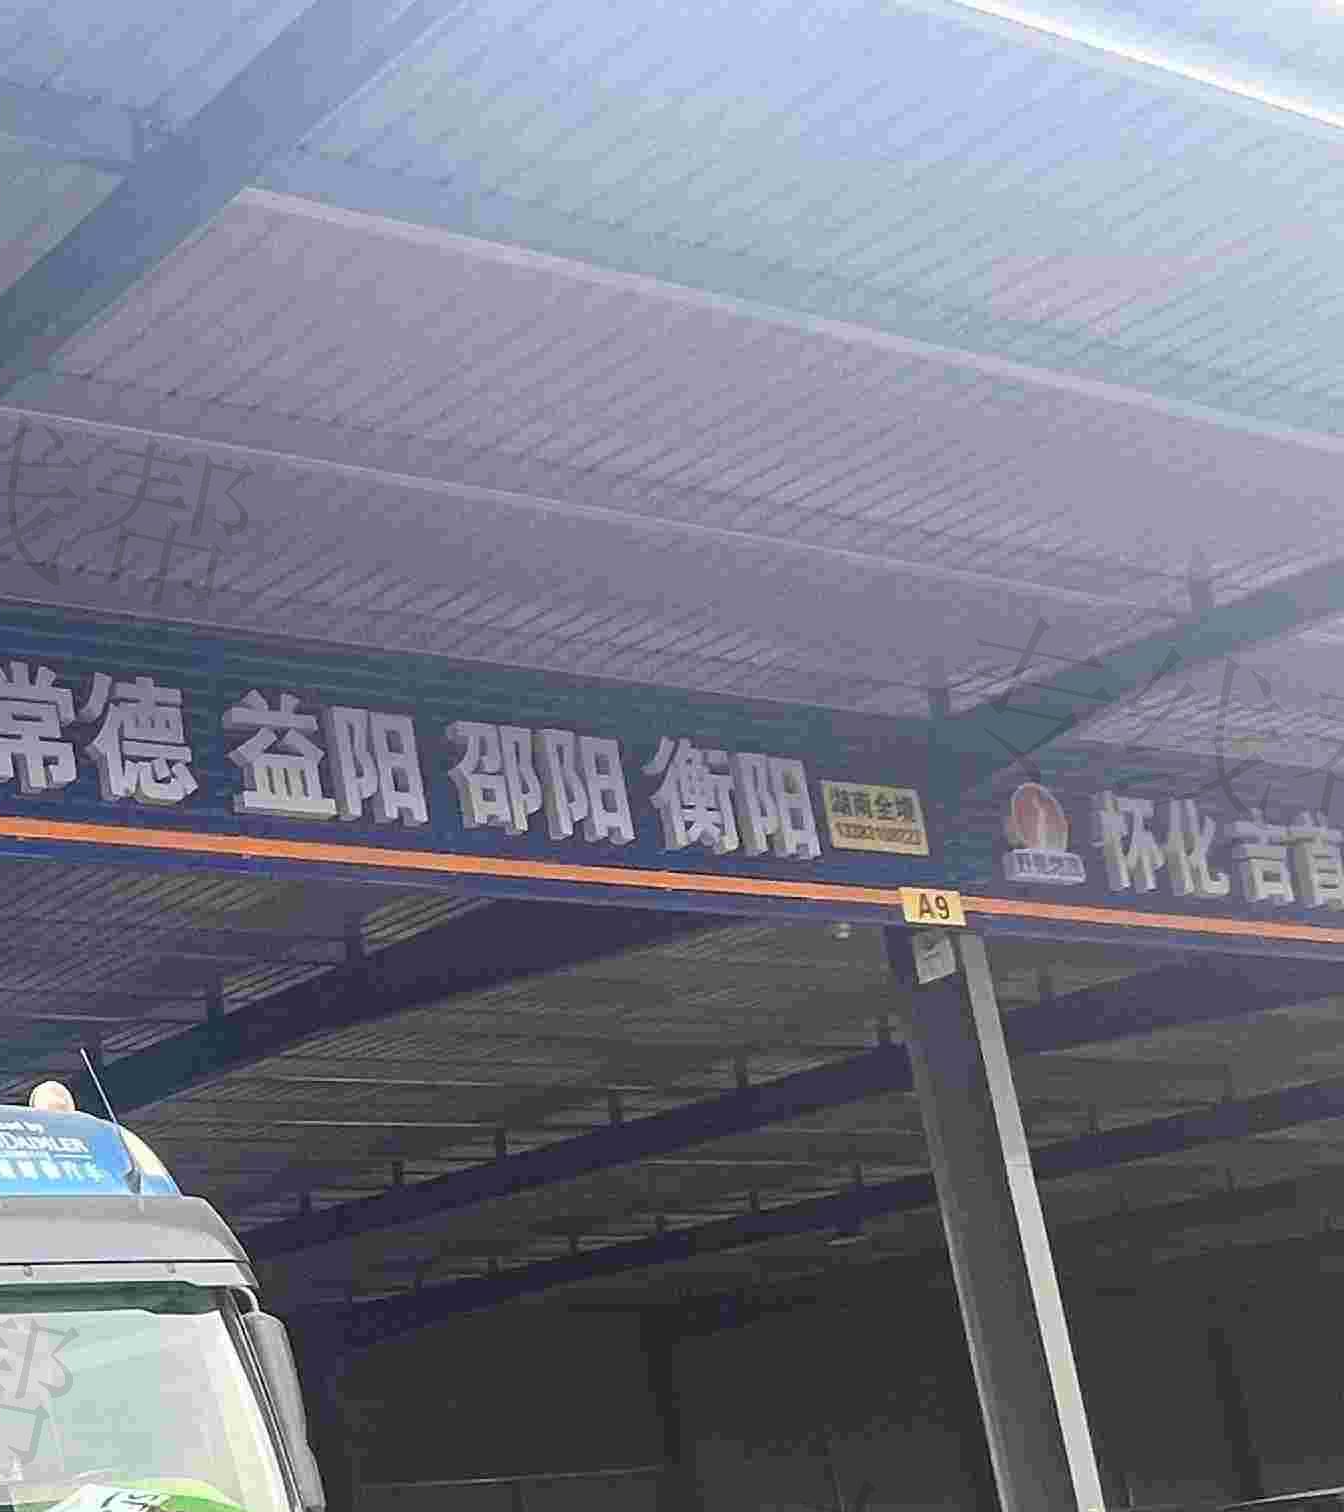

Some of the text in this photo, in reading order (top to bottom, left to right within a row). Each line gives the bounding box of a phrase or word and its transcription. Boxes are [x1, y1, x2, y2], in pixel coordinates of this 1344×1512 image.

[223, 689, 430, 827] 益阳
[446, 720, 636, 845] 邵阳
[643, 736, 822, 860] 衡阳
[917, 893, 951, 922] A9
